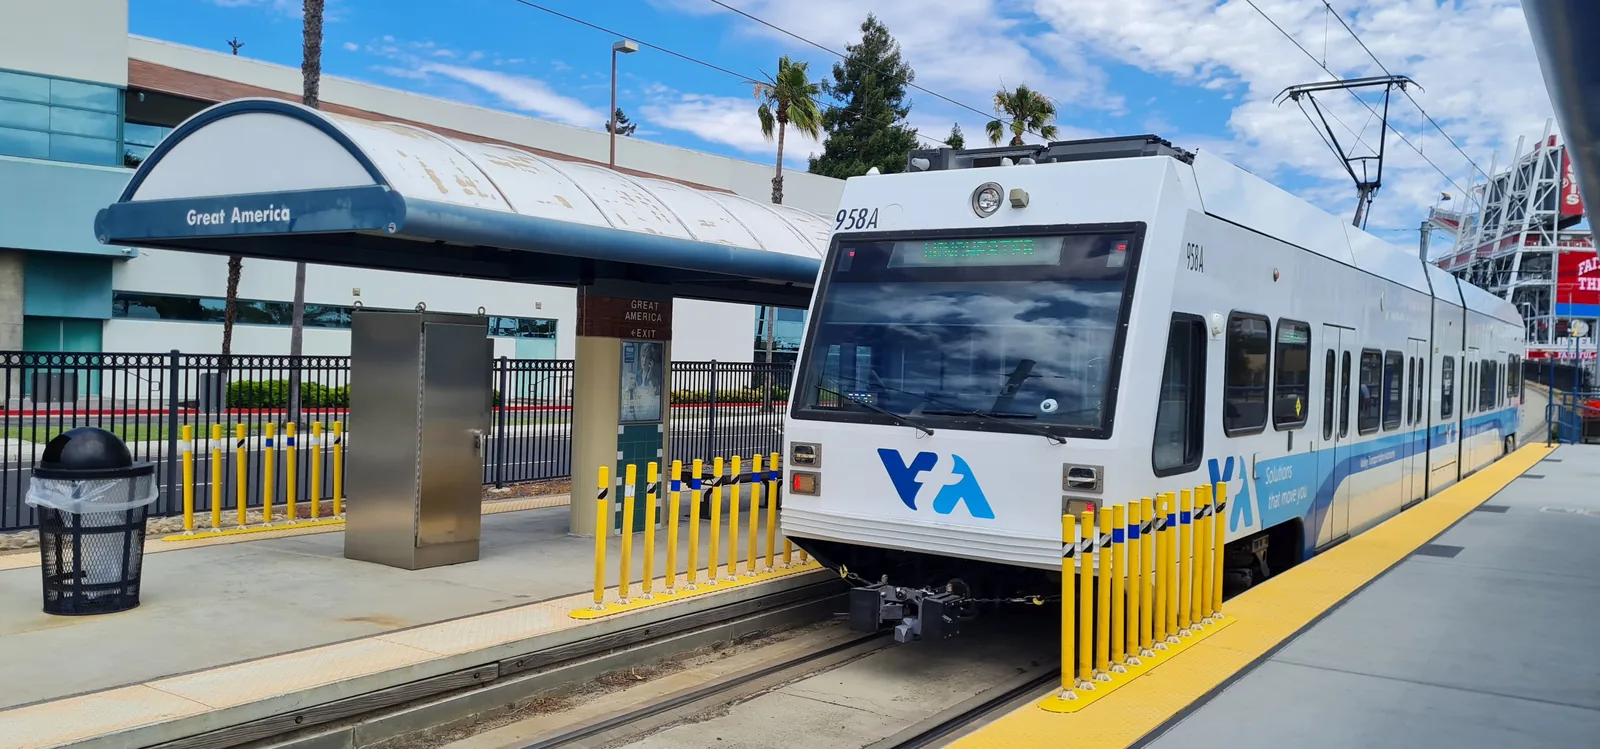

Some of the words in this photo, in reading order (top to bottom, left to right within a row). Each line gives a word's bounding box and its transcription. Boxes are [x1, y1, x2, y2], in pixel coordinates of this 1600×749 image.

[187, 209, 225, 226] Great
[231, 204, 290, 223] America
[835, 207, 878, 231] 958A
[1186, 242, 1204, 273] 958A
[1578, 256, 1600, 276] FAI
[631, 299, 660, 311] GREAT
[625, 311, 662, 322] AMERICA
[636, 328, 656, 338] EXIT
[1265, 465, 1293, 485] Solutions
[1268, 491, 1281, 510] that
[1281, 489, 1297, 505] move
[1296, 485, 1308, 505] you
